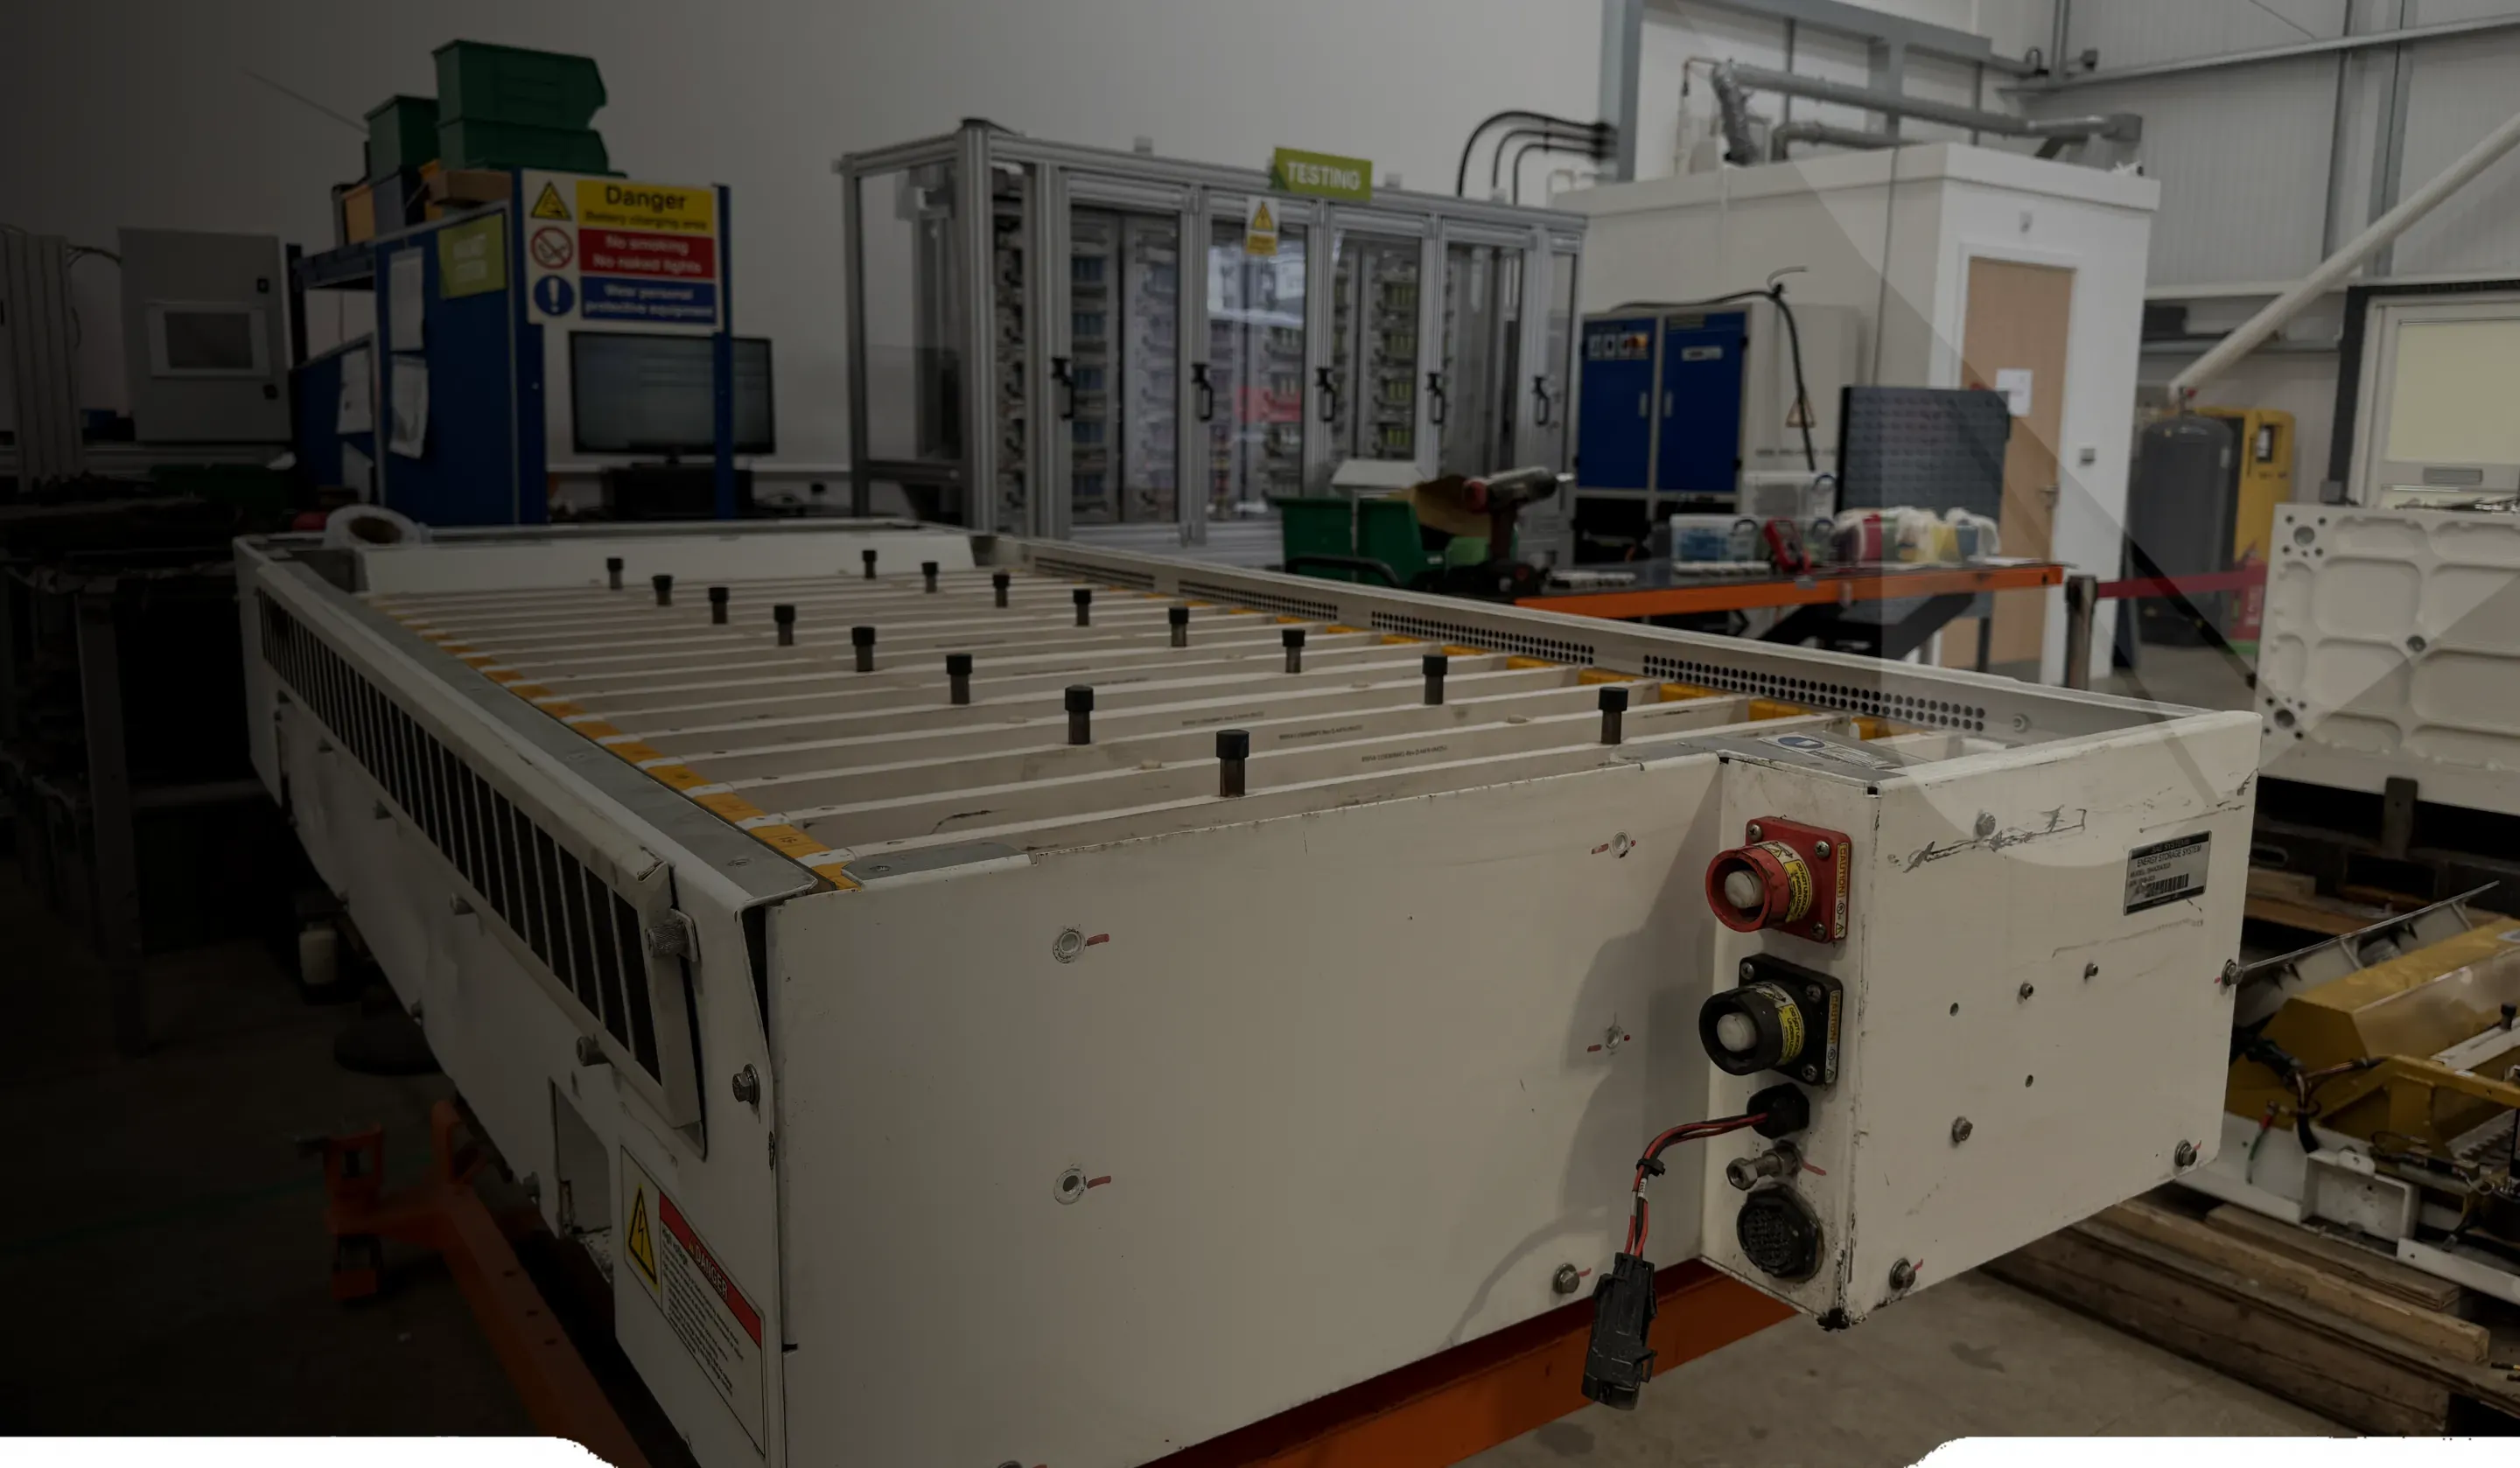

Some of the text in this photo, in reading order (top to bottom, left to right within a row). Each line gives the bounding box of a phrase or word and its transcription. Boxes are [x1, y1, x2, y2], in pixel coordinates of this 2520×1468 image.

[1286, 161, 1362, 191] TESTING
[606, 185, 687, 213] Danger
[604, 234, 690, 256] No smoking
[592, 253, 703, 276] No naked lights
[2137, 856, 2157, 868] ENERGY
[2159, 849, 2181, 862] STORAGE
[2182, 843, 2202, 856] SYSTEM
[696, 1243, 729, 1301] DANGER
